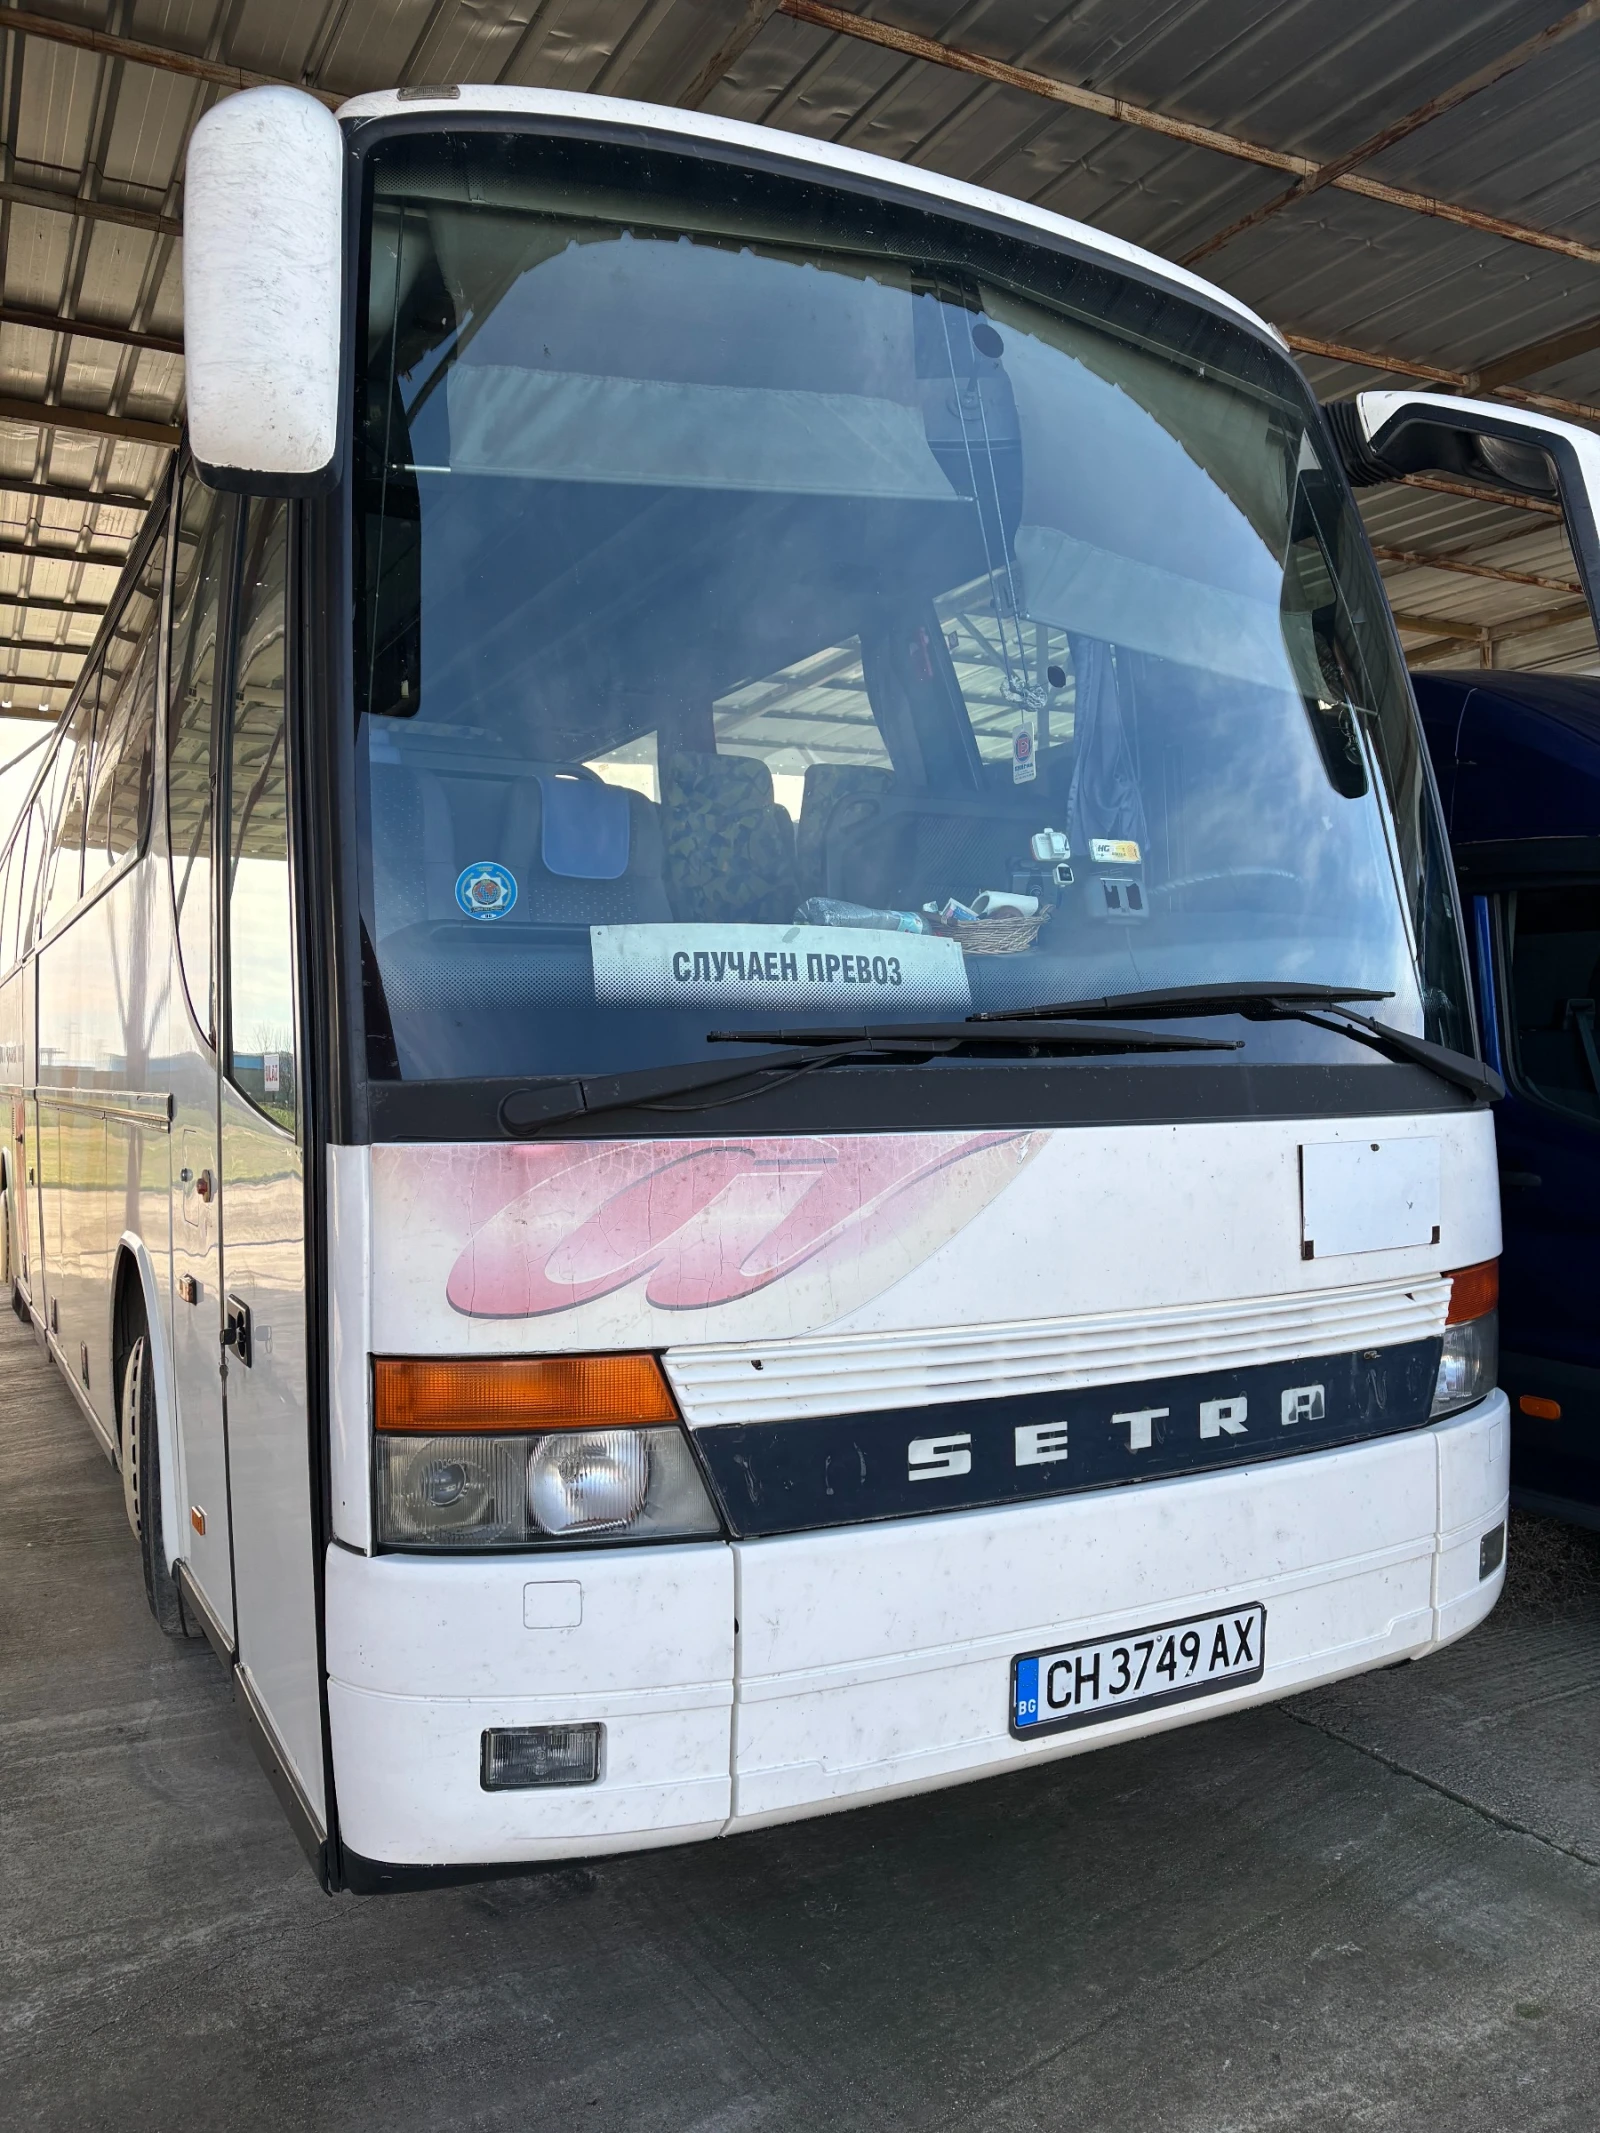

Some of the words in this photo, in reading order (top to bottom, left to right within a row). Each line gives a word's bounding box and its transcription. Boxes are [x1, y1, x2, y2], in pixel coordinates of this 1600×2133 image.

[673, 951, 798, 982] СЛУЧАЕН
[807, 953, 902, 986] ПРЕВОЗ
[907, 1384, 1326, 1482] SETRA
[1108, 1631, 1201, 1695] 3749
[1018, 1698, 1036, 1716] BG
